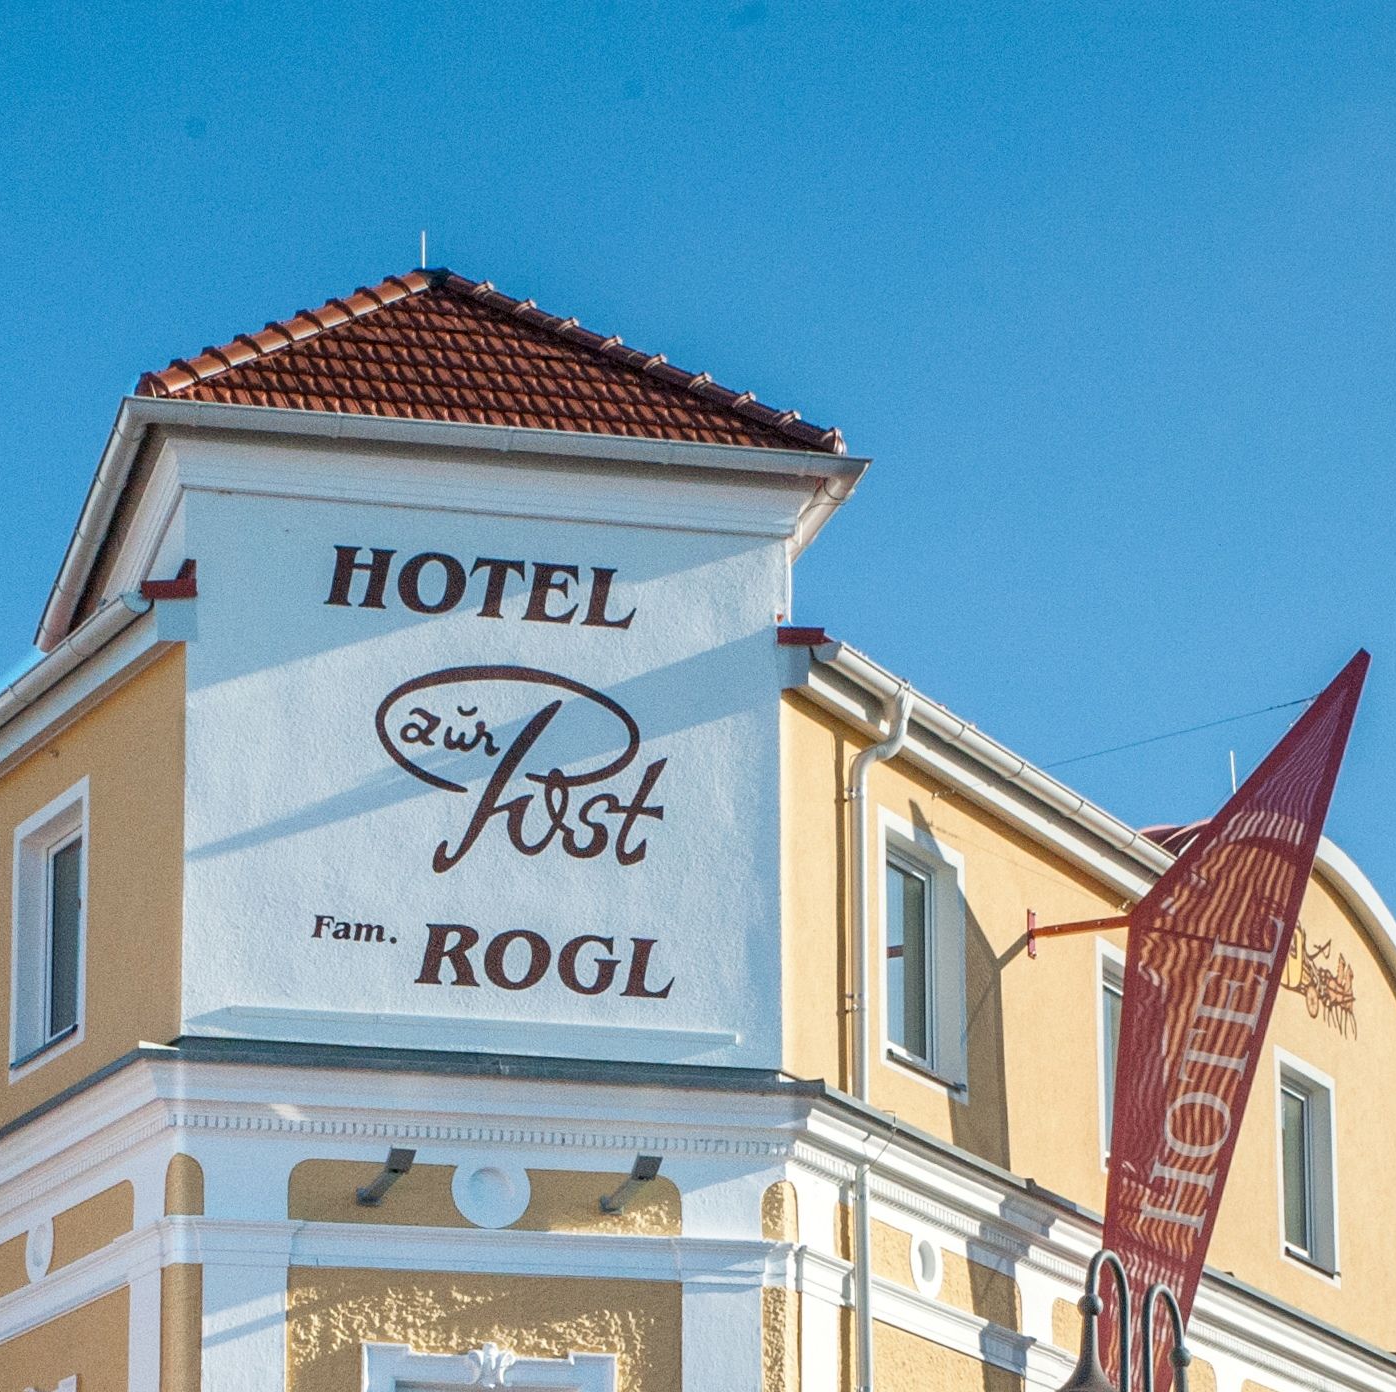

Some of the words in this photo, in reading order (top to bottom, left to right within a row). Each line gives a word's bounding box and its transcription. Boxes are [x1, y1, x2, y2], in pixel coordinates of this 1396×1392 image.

[322, 544, 638, 631] HOTEL
[374, 664, 668, 874] Post
[311, 914, 398, 944] Fam.
[413, 922, 676, 1000] ROGL
[1139, 916, 1286, 1239] HOTEL
